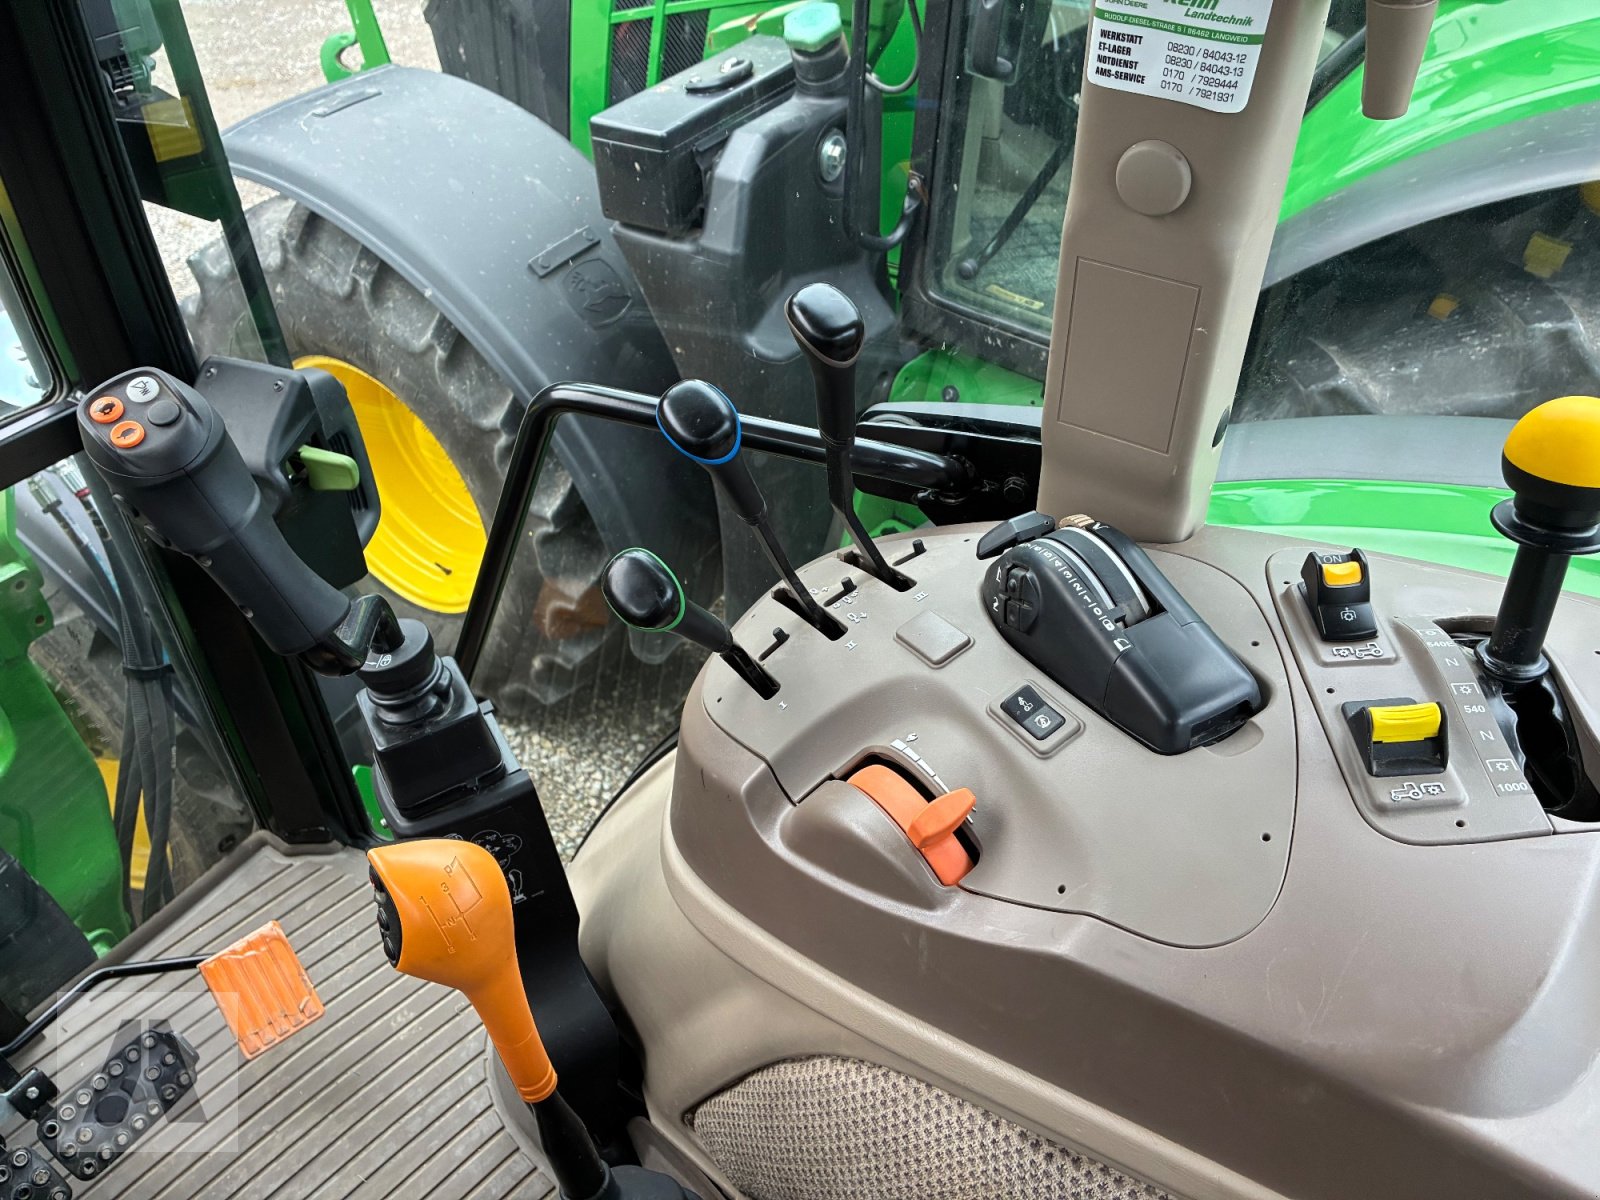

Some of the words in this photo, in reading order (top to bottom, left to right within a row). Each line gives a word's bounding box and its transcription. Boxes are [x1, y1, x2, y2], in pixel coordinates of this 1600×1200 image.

[1124, 0, 1149, 9] DEERE
[1184, 8, 1254, 27] Landtechnik
[1211, 33, 1249, 43] LANGWEID
[1100, 29, 1144, 45] WERKSTATT
[1167, 41, 1195, 56] 08230
[1202, 48, 1247, 64] 84043-12
[1098, 41, 1132, 56] ET-LAGER
[1165, 54, 1193, 69] 08230
[1199, 61, 1244, 77] 84043-13
[1096, 53, 1139, 70] NOTDIENST
[1162, 67, 1185, 81] 0170
[1197, 74, 1239, 91] 7929444
[1095, 66, 1146, 84] AMS-SERVICE
[1160, 79, 1183, 93] 0170
[1195, 87, 1235, 103] 7921931
[1323, 555, 1342, 563] ON
[1444, 657, 1460, 667] N
[1463, 705, 1486, 714] 540
[1479, 729, 1495, 741] N
[1497, 782, 1528, 792] 1000
